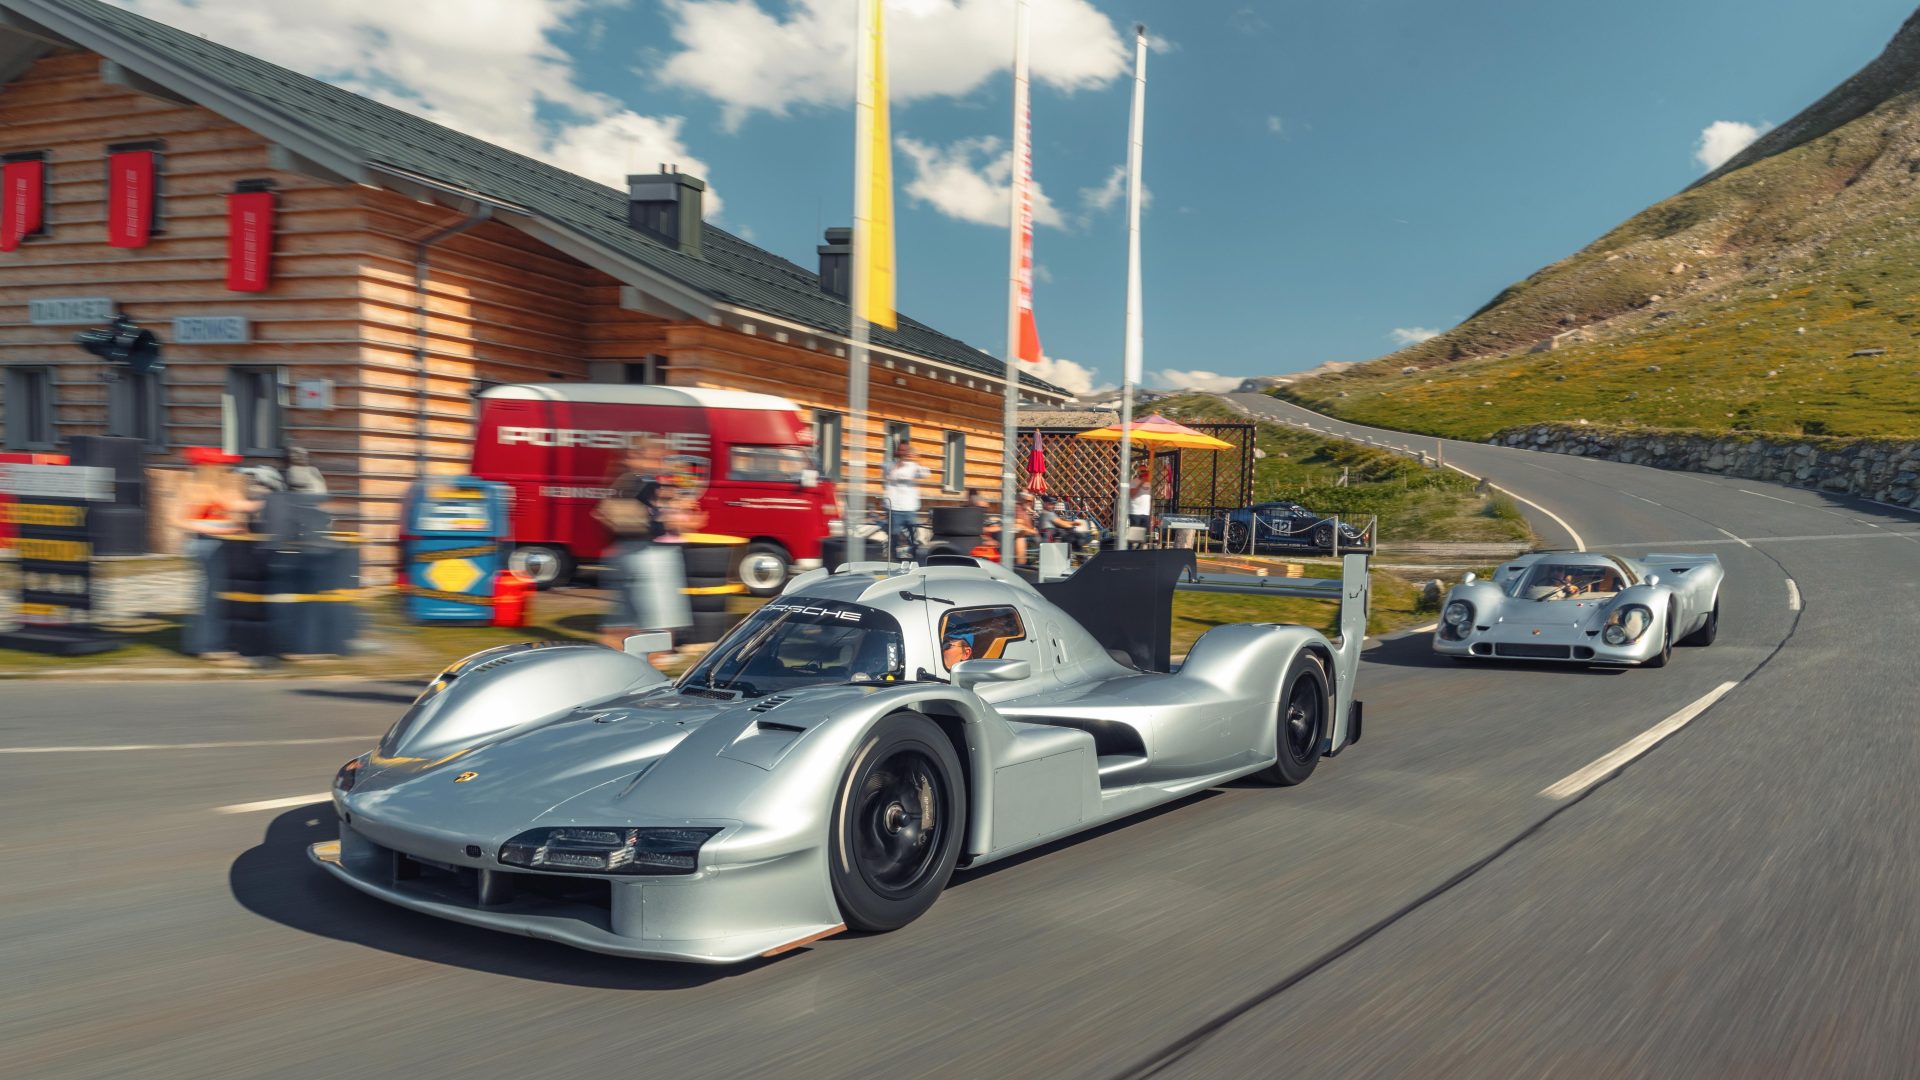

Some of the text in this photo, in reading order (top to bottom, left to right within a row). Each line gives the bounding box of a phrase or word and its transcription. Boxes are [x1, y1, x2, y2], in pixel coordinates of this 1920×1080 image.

[497, 426, 711, 451] PORSCHE
[1274, 521, 1289, 534] 12
[760, 604, 862, 621] ORSCHE
